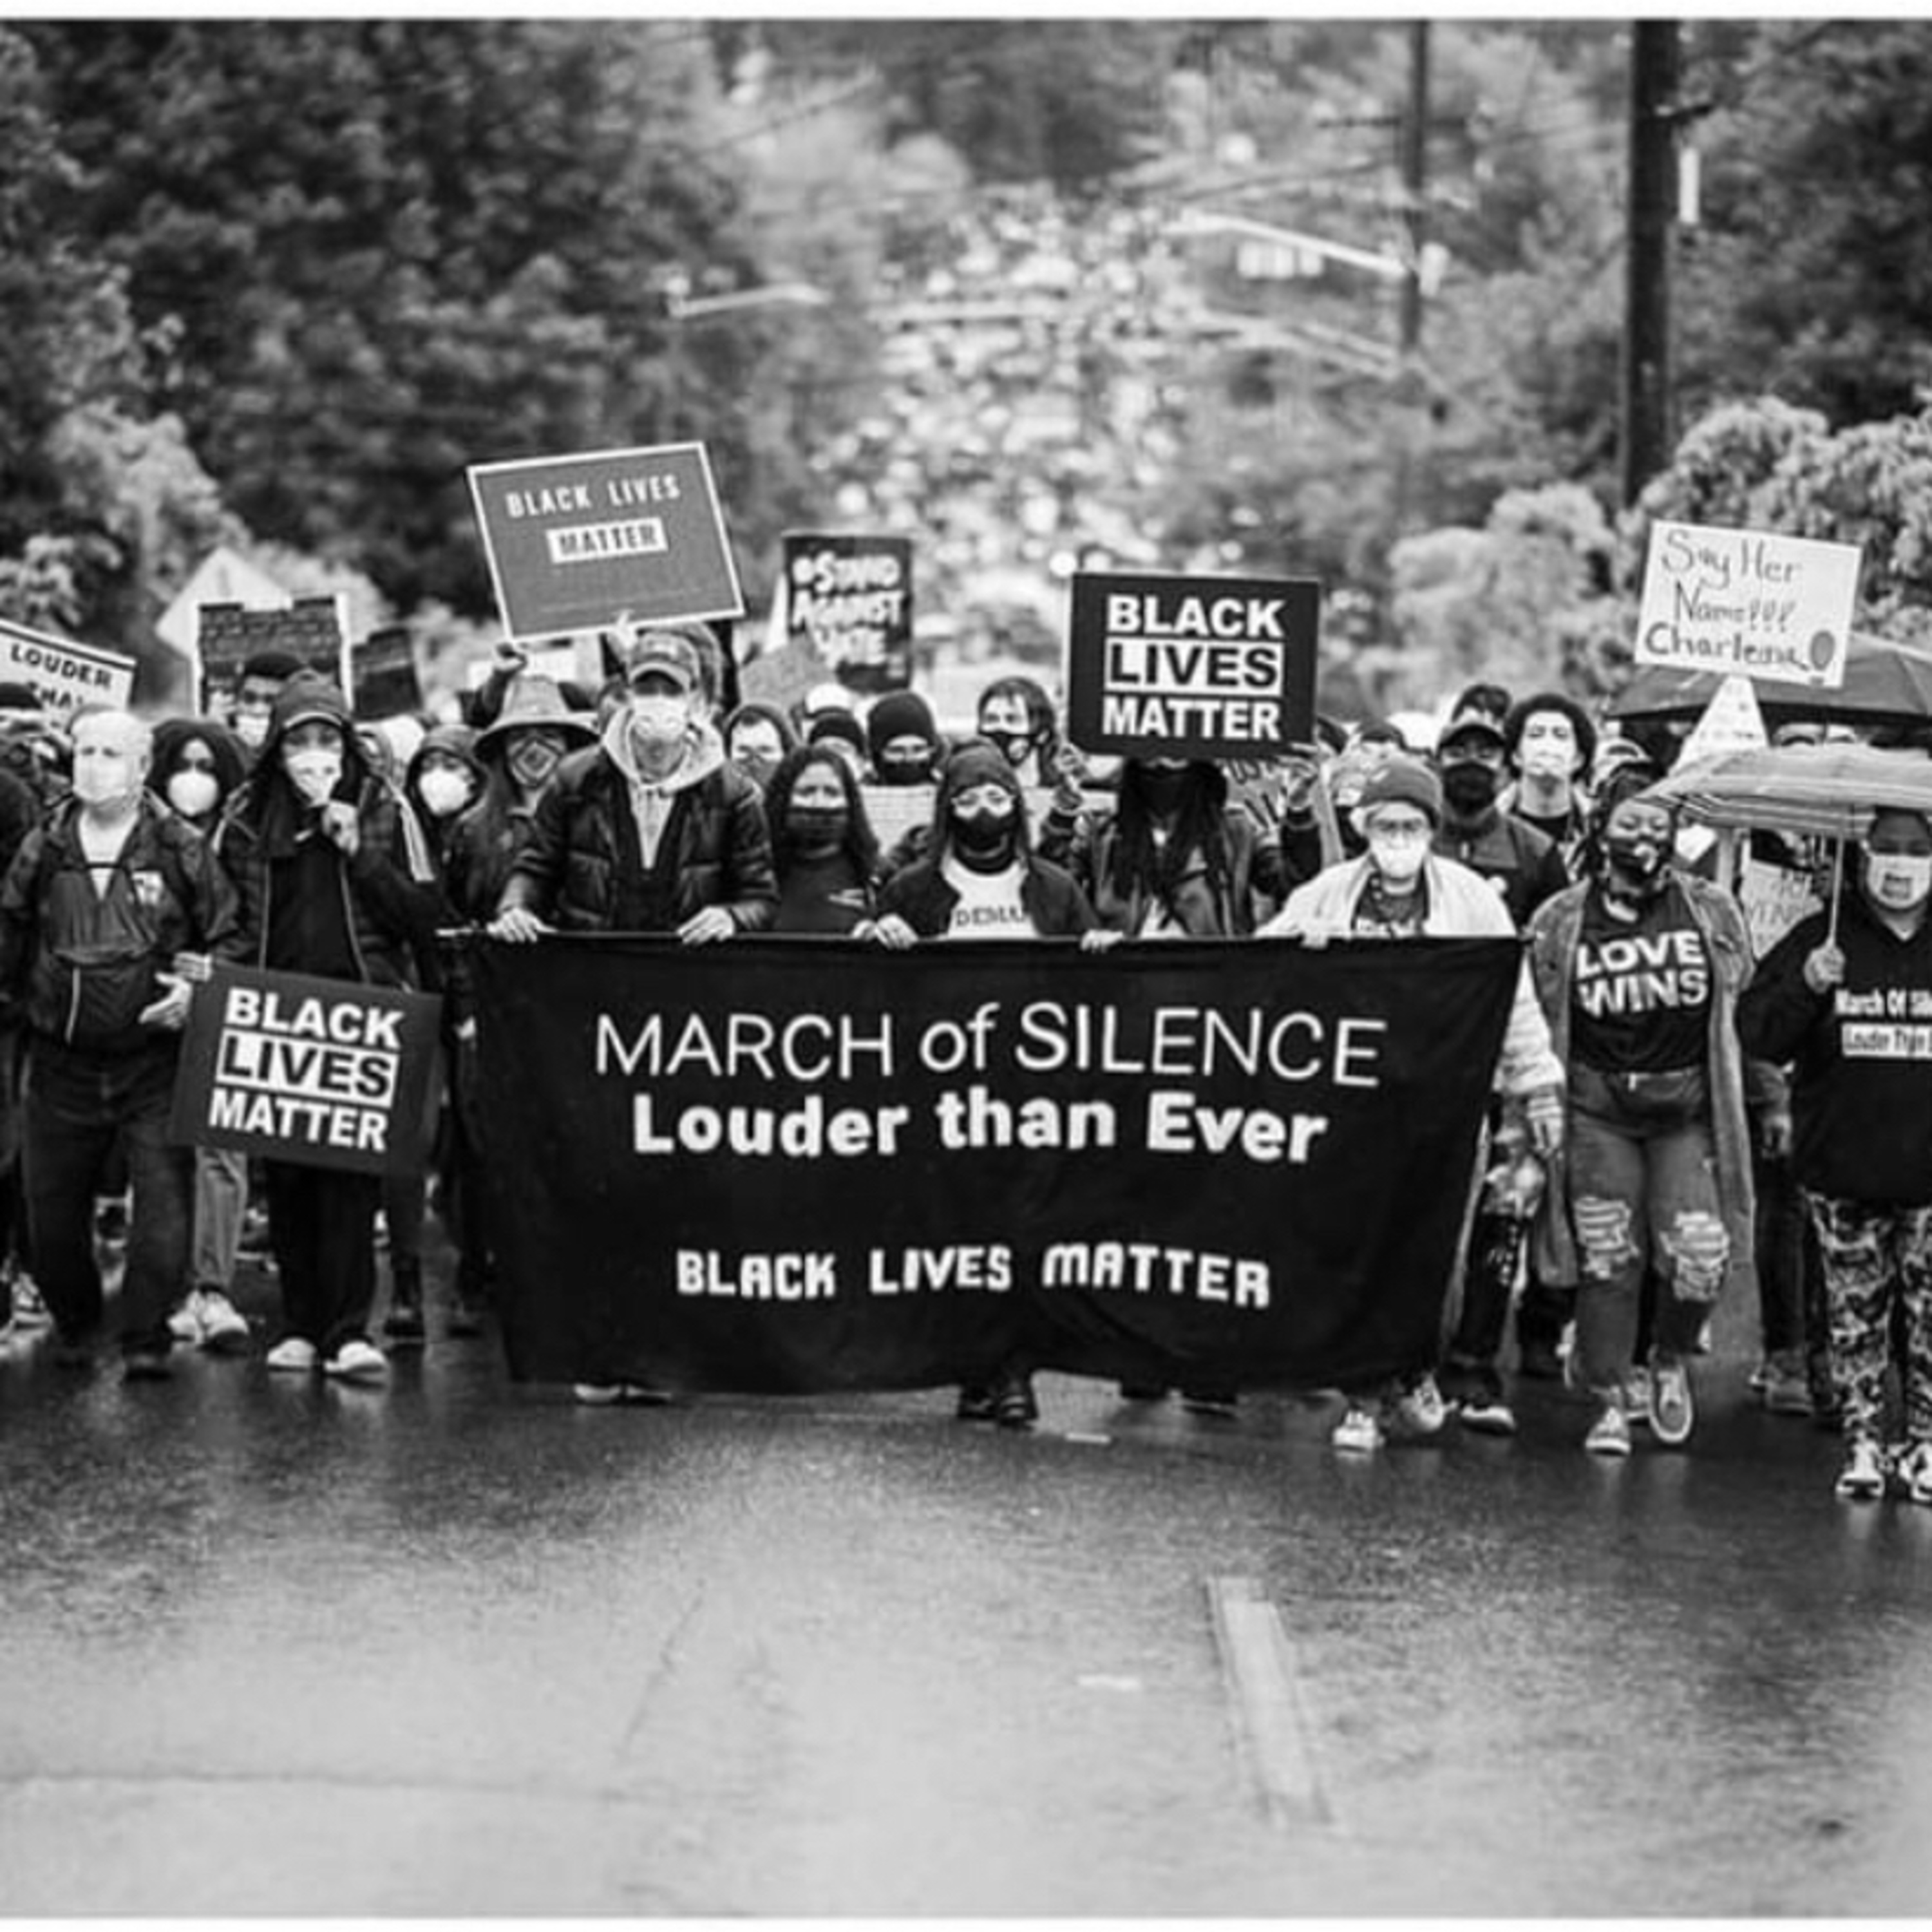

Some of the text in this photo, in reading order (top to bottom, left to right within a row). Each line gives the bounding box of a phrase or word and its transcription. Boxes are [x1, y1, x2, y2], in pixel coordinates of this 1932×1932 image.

[505, 474, 680, 517] BLACK LIVES
[558, 524, 659, 555] MATTER
[1662, 529, 1795, 590] Say Her
[1107, 594, 1285, 638] BLACK
[10, 643, 112, 691] LOUDER
[1110, 643, 1278, 688] LIVES
[1102, 696, 1280, 740] MATTER
[1577, 930, 1705, 979] LOVE
[225, 987, 404, 1049] BLACK
[1578, 969, 1708, 1018] WINS
[223, 1035, 392, 1097] LIVES
[596, 1001, 1387, 1087] MARCH of SILENCE
[208, 1088, 388, 1151] MATTER
[633, 1085, 1329, 1163] Louder than Ever
[677, 1242, 1270, 1309] BLACK LIVES MATTER
